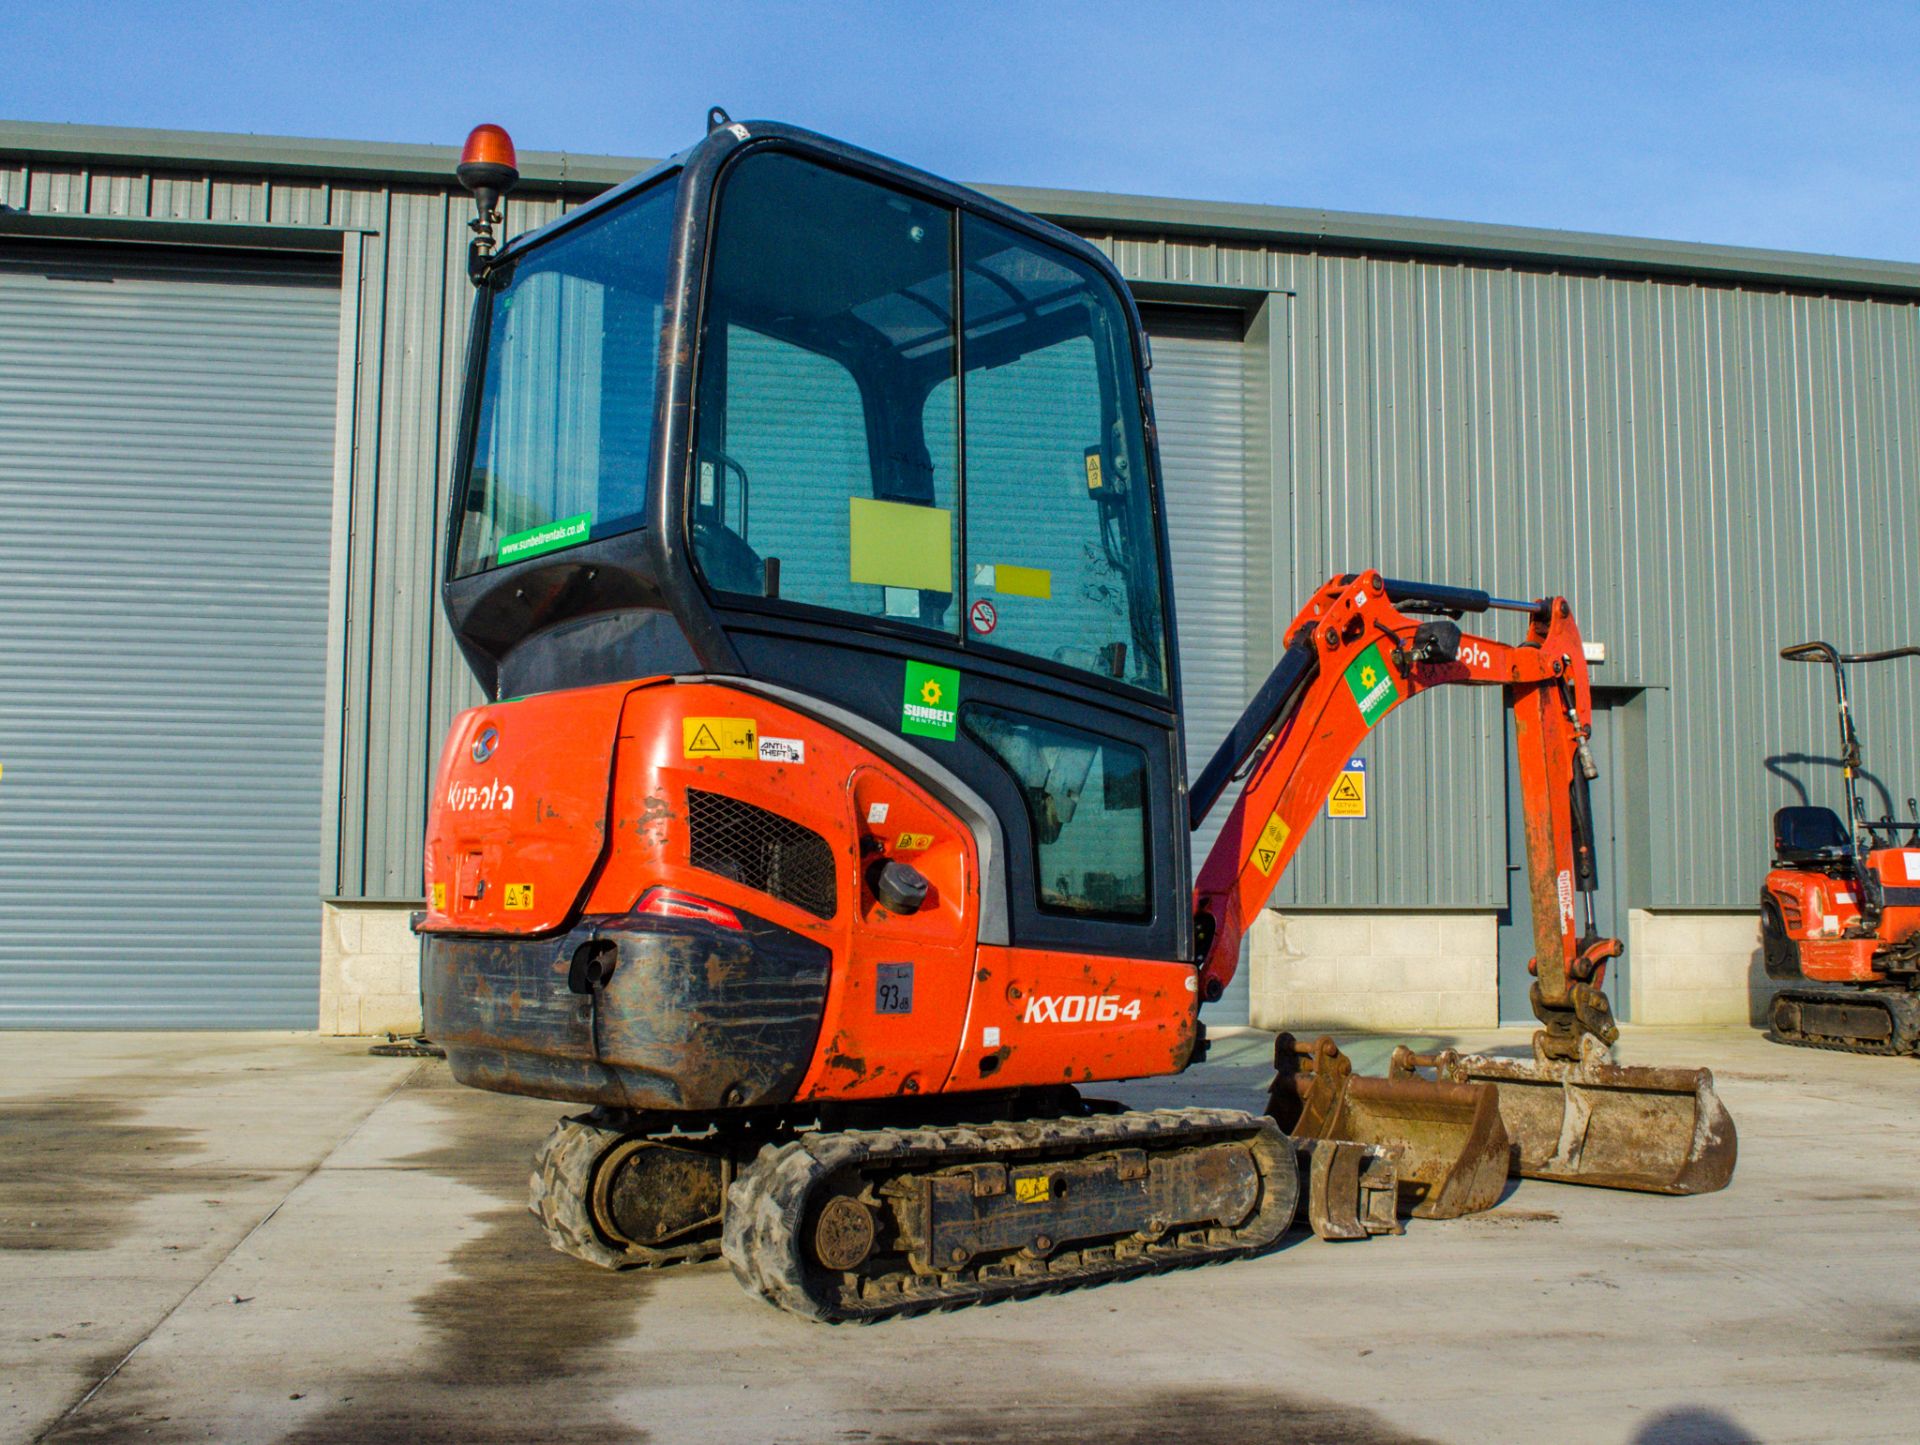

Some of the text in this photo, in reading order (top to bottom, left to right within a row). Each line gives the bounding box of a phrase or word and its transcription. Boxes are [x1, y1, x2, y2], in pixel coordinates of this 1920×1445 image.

[502, 519, 586, 555] www.sunbeltrentals.co.uk
[1359, 674, 1392, 713] SUNBELT
[903, 703, 955, 723] SUNBELT
[910, 716, 947, 728] RENTALS
[759, 748, 787, 757] THEFT
[447, 776, 514, 811] Kubota
[879, 984, 899, 1011] 93
